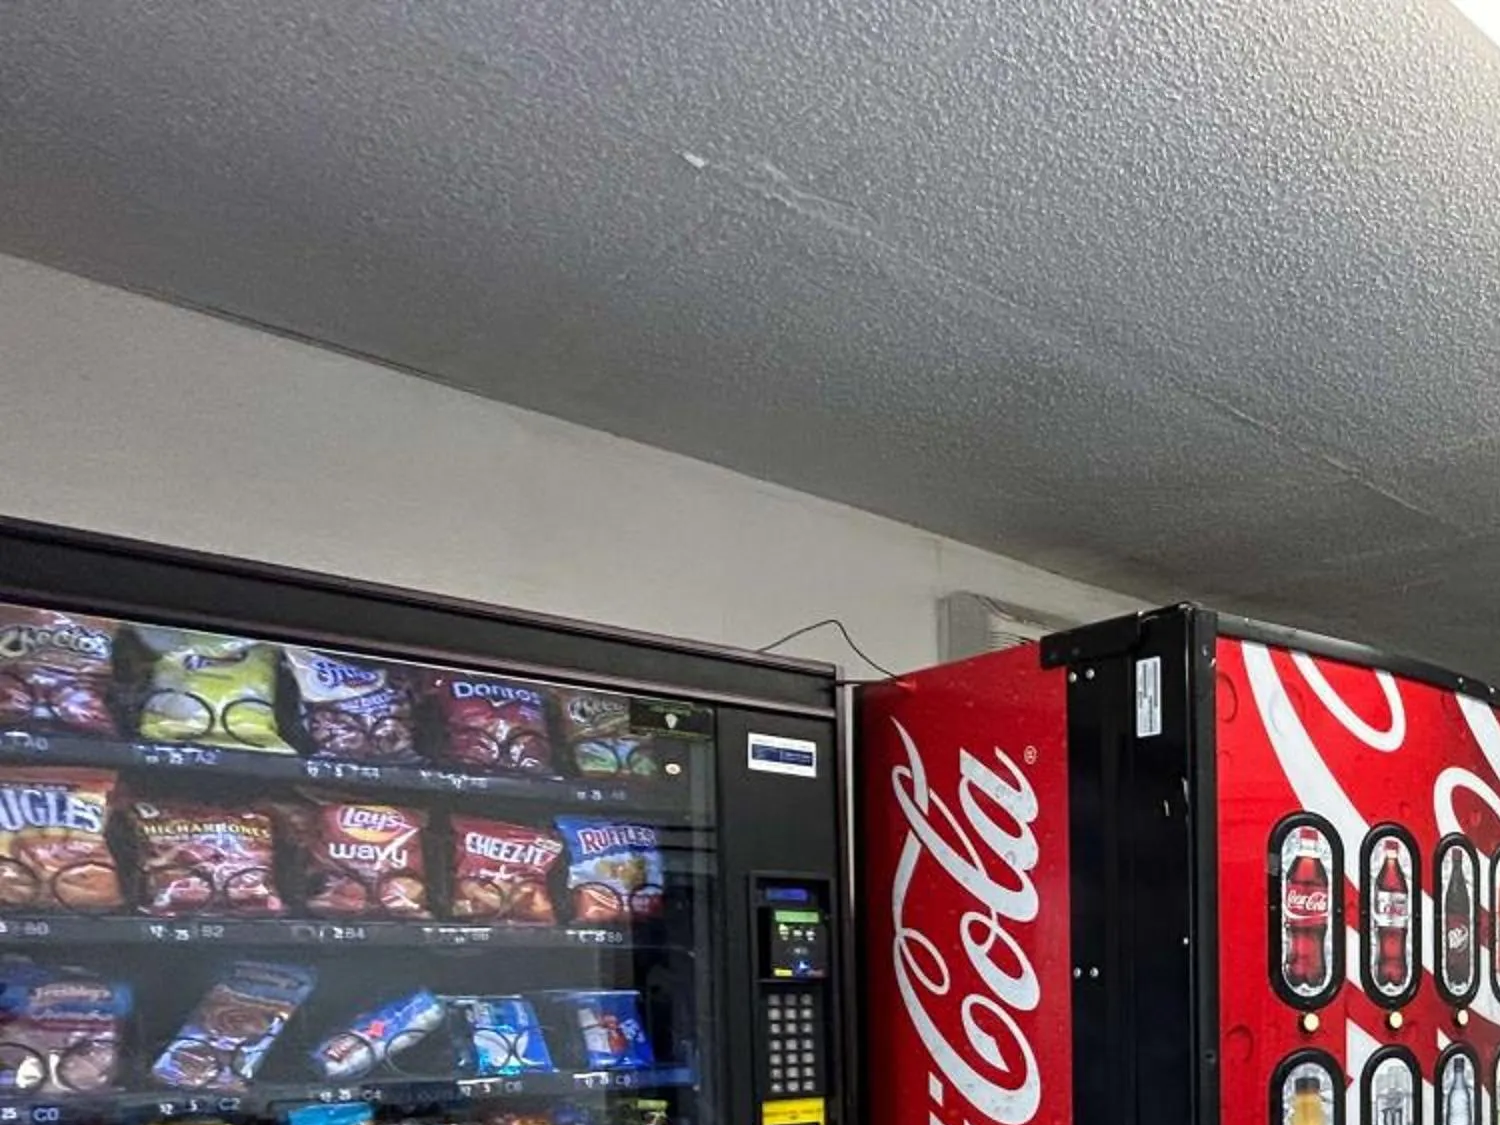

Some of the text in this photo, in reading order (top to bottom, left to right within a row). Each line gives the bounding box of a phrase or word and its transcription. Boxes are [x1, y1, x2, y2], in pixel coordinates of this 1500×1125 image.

[452, 681, 543, 705] Doritos
[0, 788, 106, 834] UGLES
[1286, 890, 1327, 912] Coca-Cola
